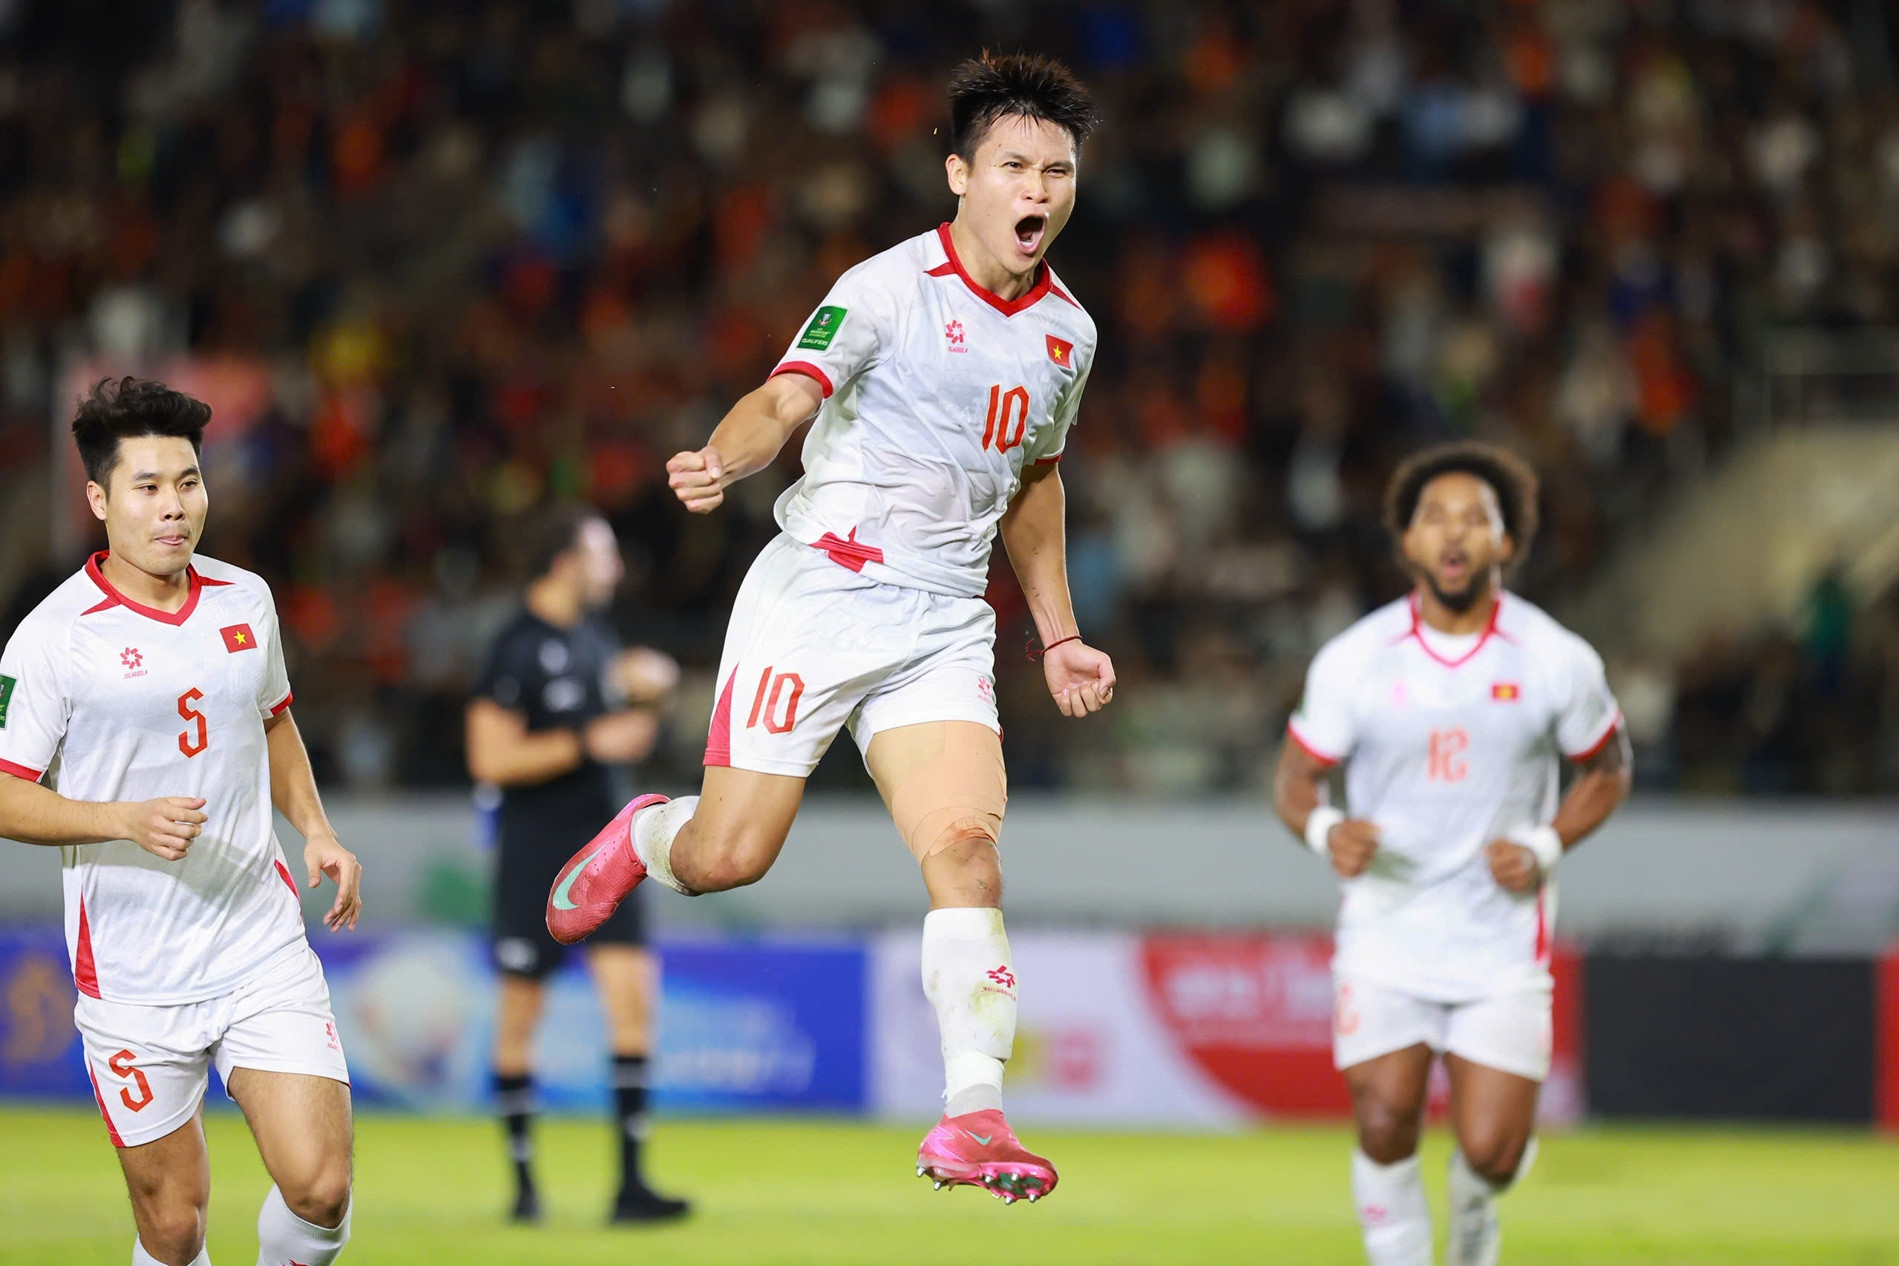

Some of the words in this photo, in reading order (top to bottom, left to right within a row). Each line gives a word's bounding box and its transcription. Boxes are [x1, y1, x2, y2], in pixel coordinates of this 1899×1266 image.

[981, 383, 1031, 455] 10
[177, 686, 208, 759] 5
[745, 665, 806, 735] 10
[1427, 726, 1470, 783] 12
[108, 1048, 154, 1114] 5
